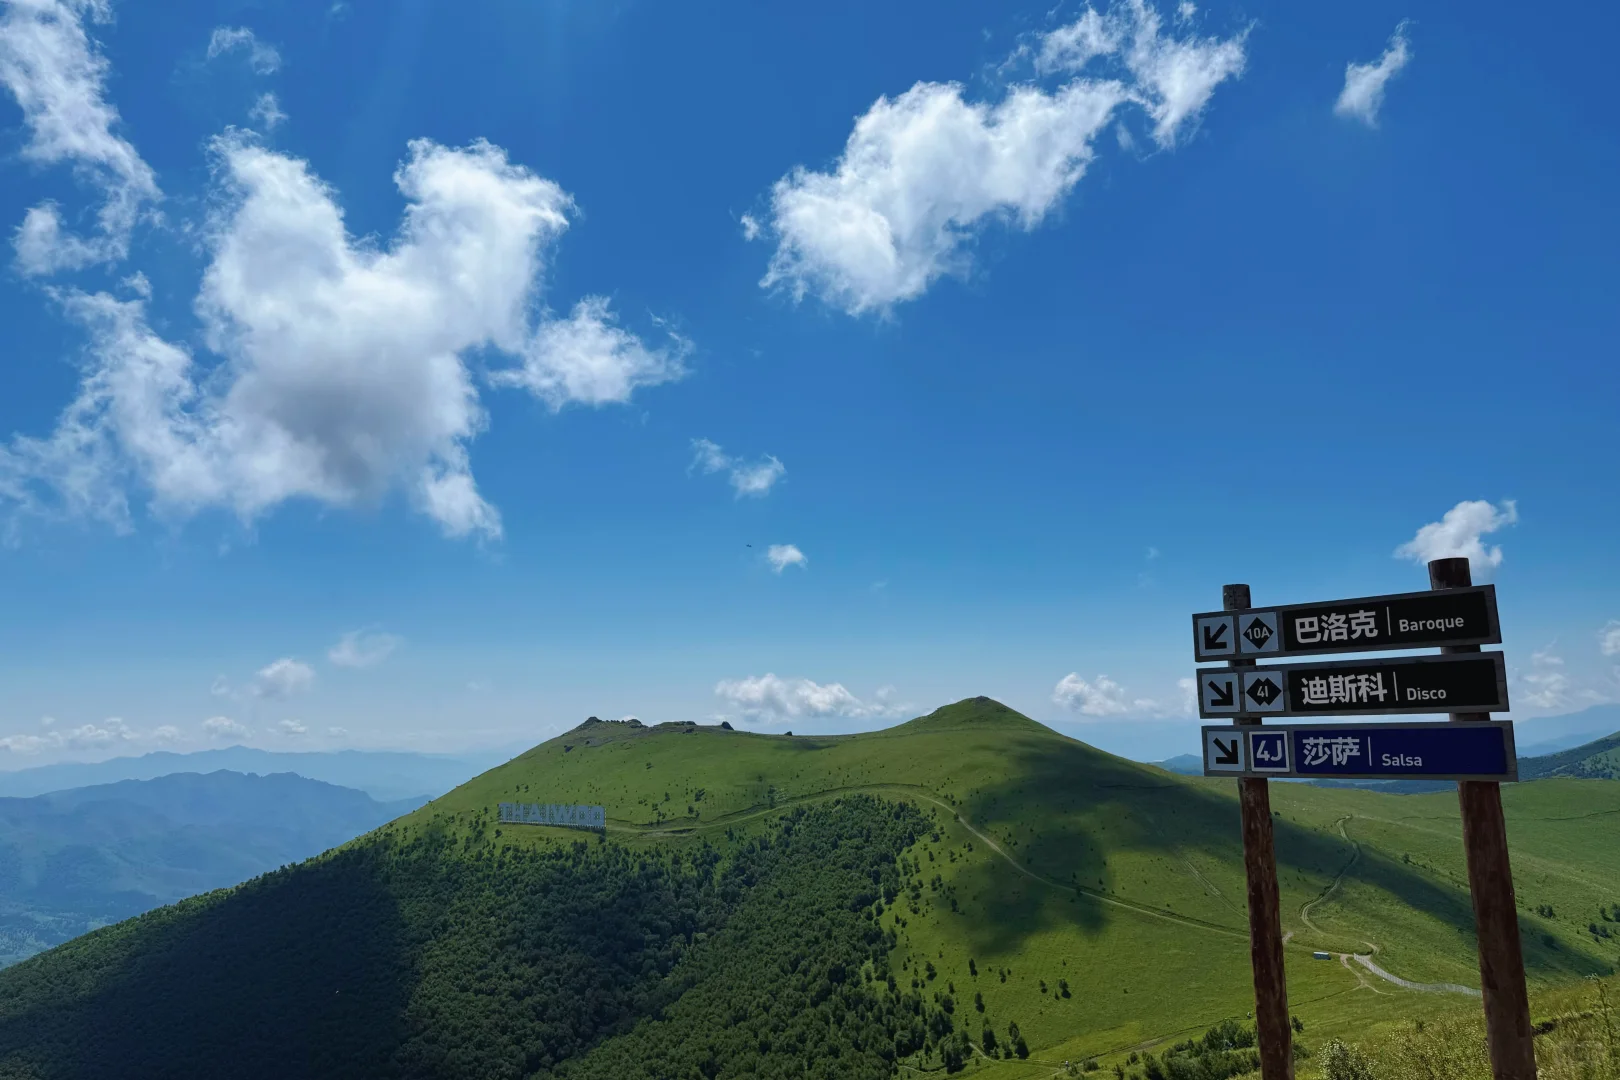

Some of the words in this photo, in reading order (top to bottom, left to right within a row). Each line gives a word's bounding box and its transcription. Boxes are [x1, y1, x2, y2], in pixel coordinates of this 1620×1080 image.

[1246, 626, 1270, 640] 10A
[1295, 610, 1379, 644] 巴洛克
[1399, 615, 1465, 632] Baroque
[1301, 673, 1388, 705] 迪斯科
[1407, 687, 1447, 701] Disco
[1256, 740, 1283, 762] 4J
[1302, 737, 1361, 766] 莎萨
[1381, 753, 1423, 767] Salsa
[498, 802, 605, 827] THAIWOO
